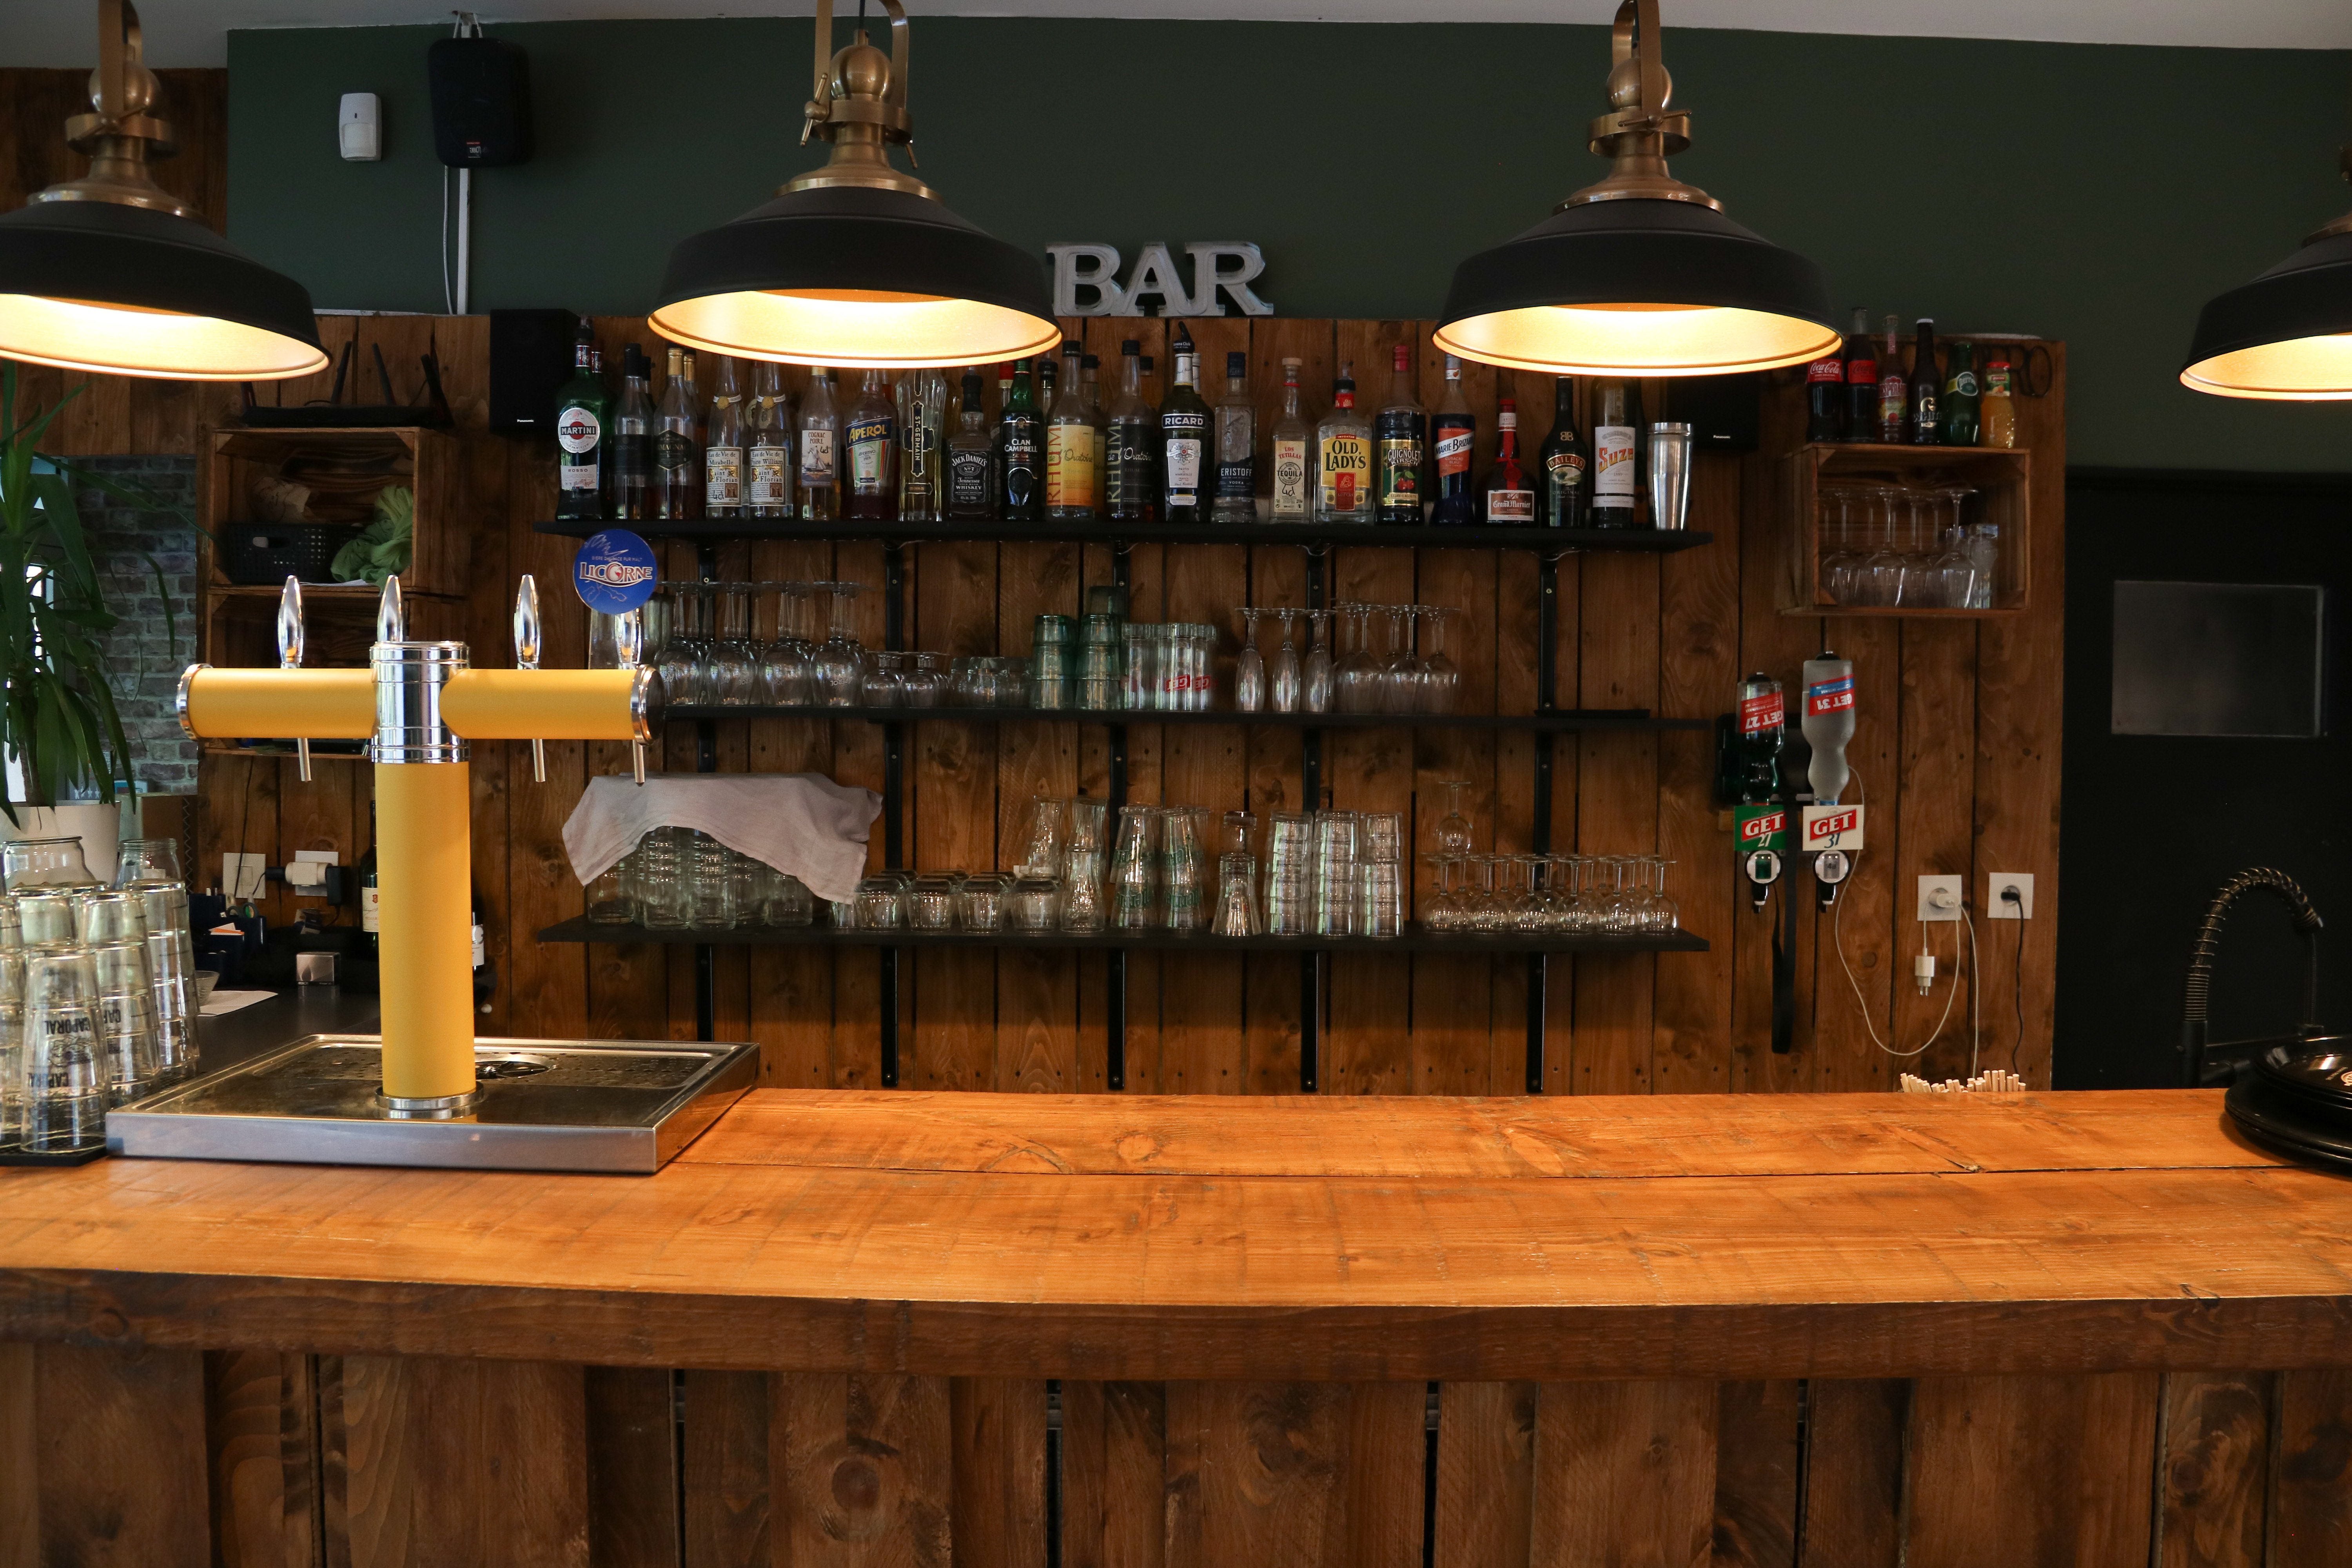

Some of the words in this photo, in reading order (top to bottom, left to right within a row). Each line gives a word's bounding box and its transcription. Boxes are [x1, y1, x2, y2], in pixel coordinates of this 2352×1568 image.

[1045, 241, 1274, 316] BAR
[1810, 362, 1840, 374] Coca-Cola
[1165, 417, 1204, 426] RICARD
[848, 425, 887, 443] APEROL
[1004, 444, 1038, 452] CAMPBELL
[1332, 440, 1358, 455] OLD
[1436, 443, 1452, 454] MARIE
[1453, 436, 1474, 452] BRIZARD
[952, 456, 965, 466] JACK
[965, 454, 987, 466] DANIEL'S
[1108, 449, 1115, 461] de
[1388, 449, 1421, 464] GUIGNOLET
[1549, 456, 1584, 467] BAILEYS
[1599, 447, 1633, 474] Suze
[1047, 427, 1062, 503] RHUM
[1107, 425, 1121, 503] RHUM
[1221, 468, 1252, 477] ERISTOFF
[1493, 500, 1510, 508] Grand
[1509, 500, 1531, 508] Marnier
[579, 562, 653, 584] LICORNE
[1817, 699, 1831, 710] 31
[1833, 693, 1852, 707] GET
[1745, 716, 1761, 729] 27
[1762, 710, 1782, 726] GET
[1745, 813, 1784, 836] GET
[1813, 813, 1852, 835] GET
[1757, 831, 1772, 847] 27
[1824, 832, 1840, 848] 31
[45, 1017, 91, 1035] CAPORAL
